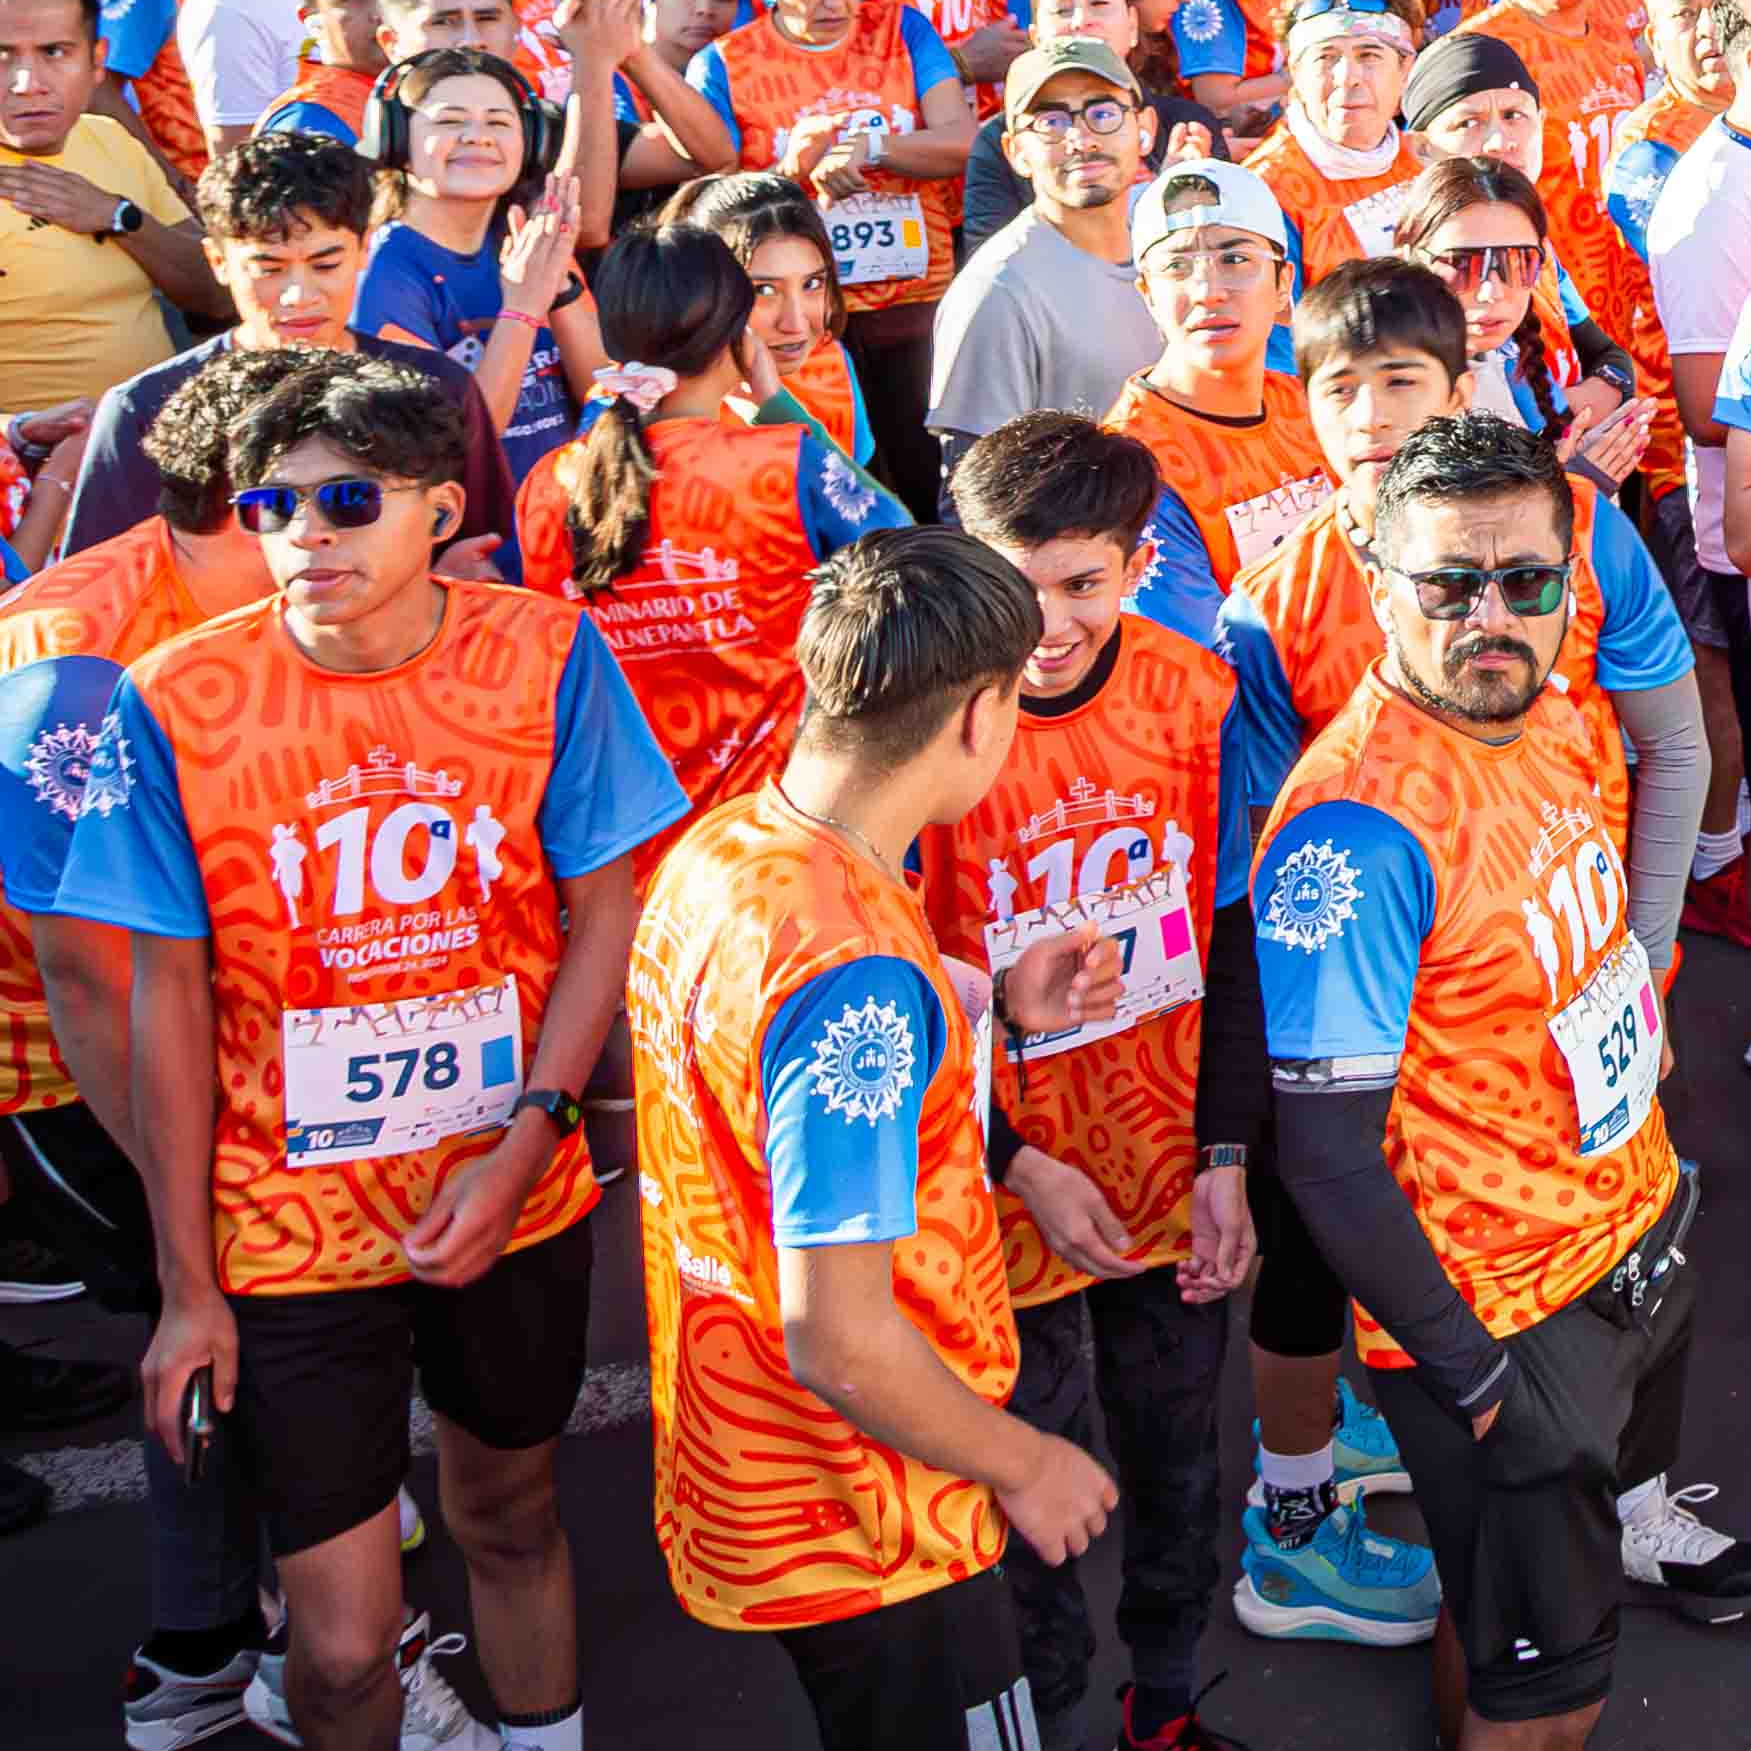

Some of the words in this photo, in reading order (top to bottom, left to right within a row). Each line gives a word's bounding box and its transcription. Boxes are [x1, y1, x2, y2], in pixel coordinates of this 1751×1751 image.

[831, 219, 896, 253] 893
[593, 596, 694, 625] MINARIO
[702, 587, 740, 610] DE
[316, 916, 394, 946] CARRERA
[399, 913, 432, 932] POR
[443, 905, 478, 927] LAS
[319, 924, 479, 969] VOCACIONES
[1598, 1004, 1639, 1088] 529
[344, 1041, 460, 1103] 578
[305, 1129, 335, 1149] 10
